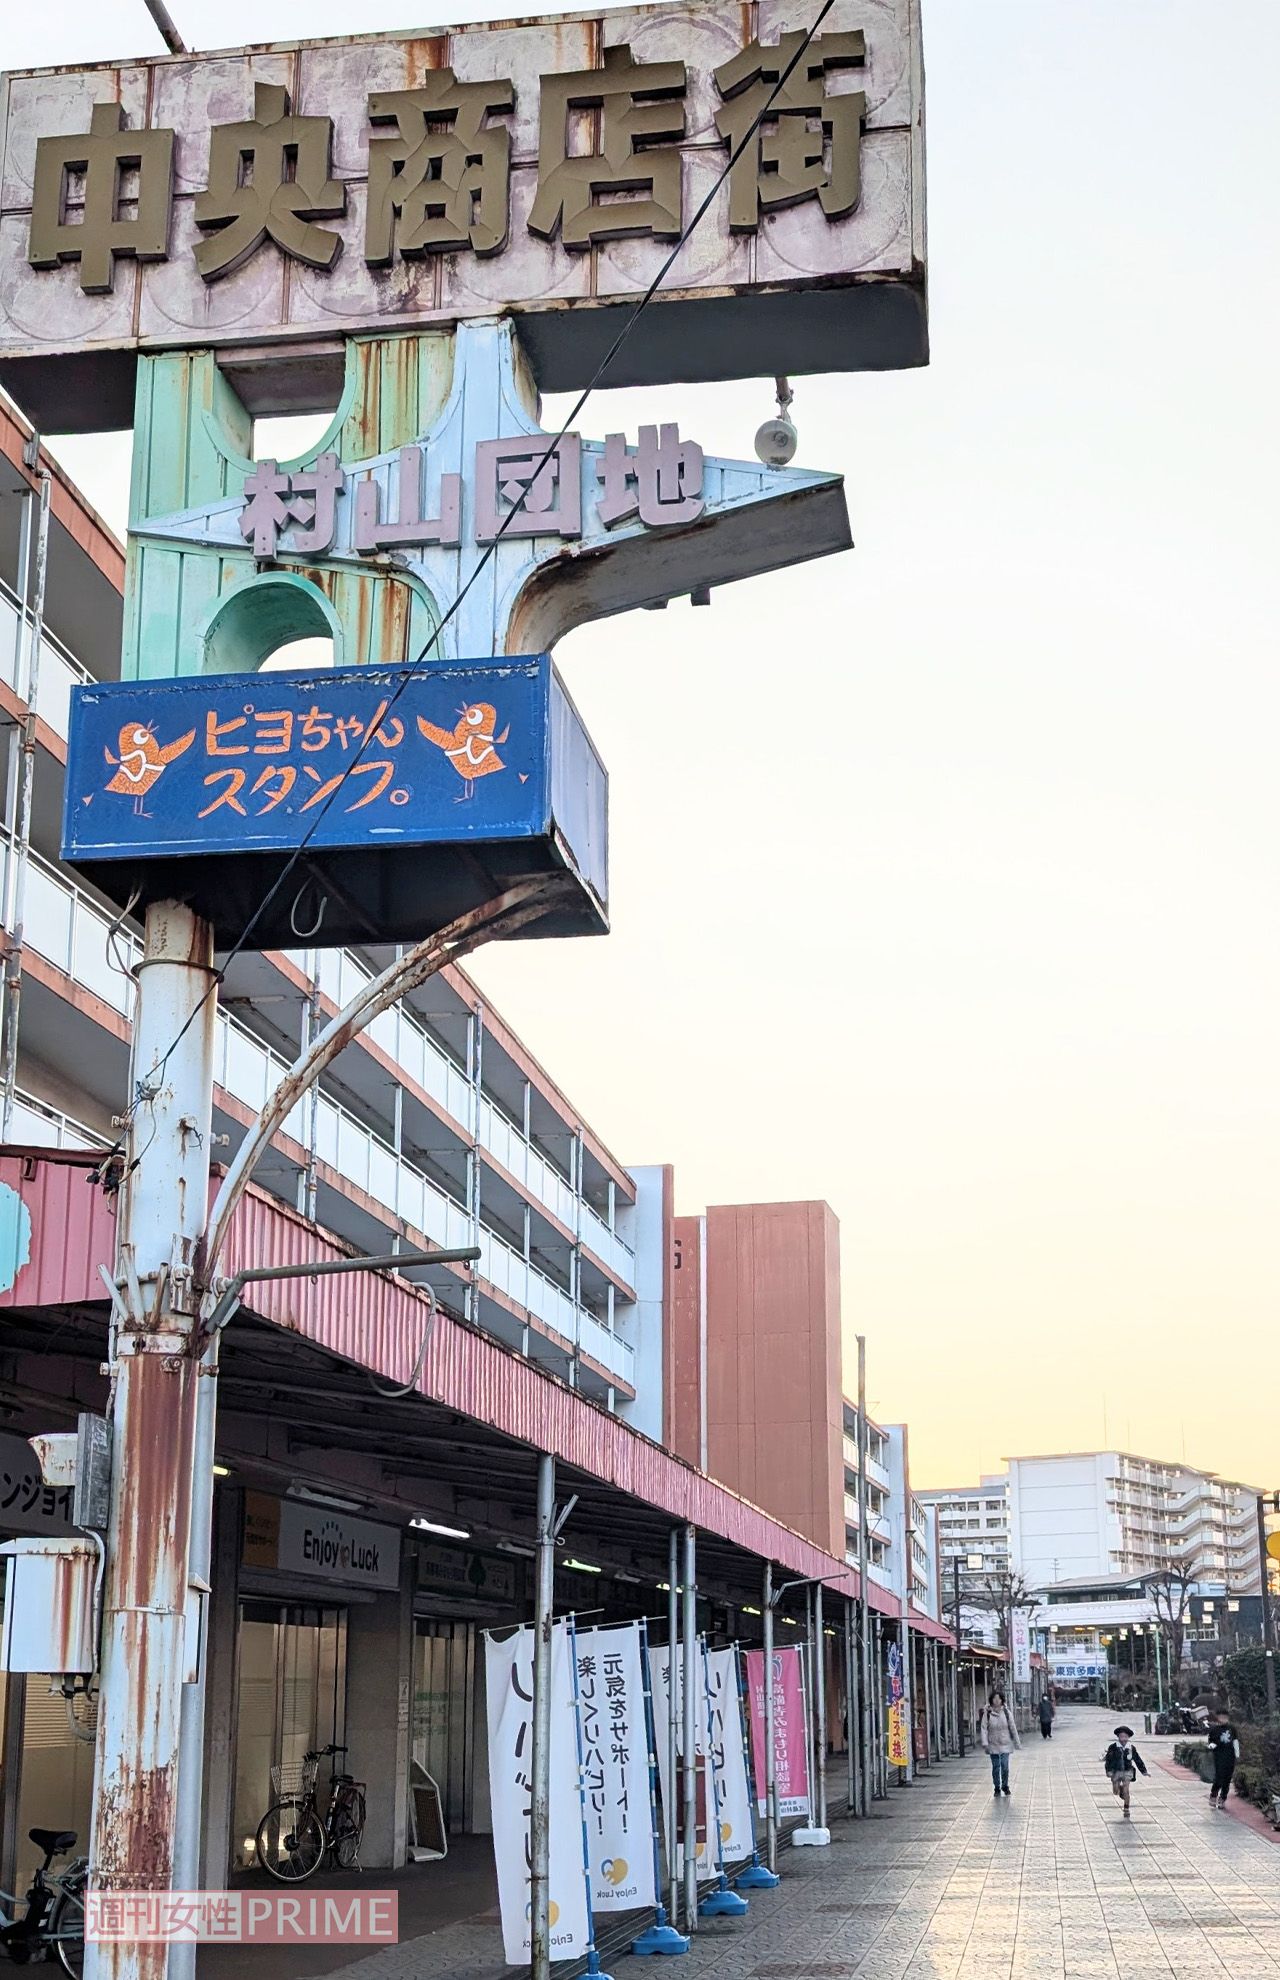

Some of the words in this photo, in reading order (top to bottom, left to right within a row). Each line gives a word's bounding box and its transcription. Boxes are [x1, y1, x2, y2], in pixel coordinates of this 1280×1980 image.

[28, 28, 868, 297] 中央商店街
[237, 422, 706, 562] 村山団地
[206, 700, 404, 756] ピヨちゃん
[303, 1528, 340, 1569] Enjoy
[351, 1538, 380, 1572] Luck
